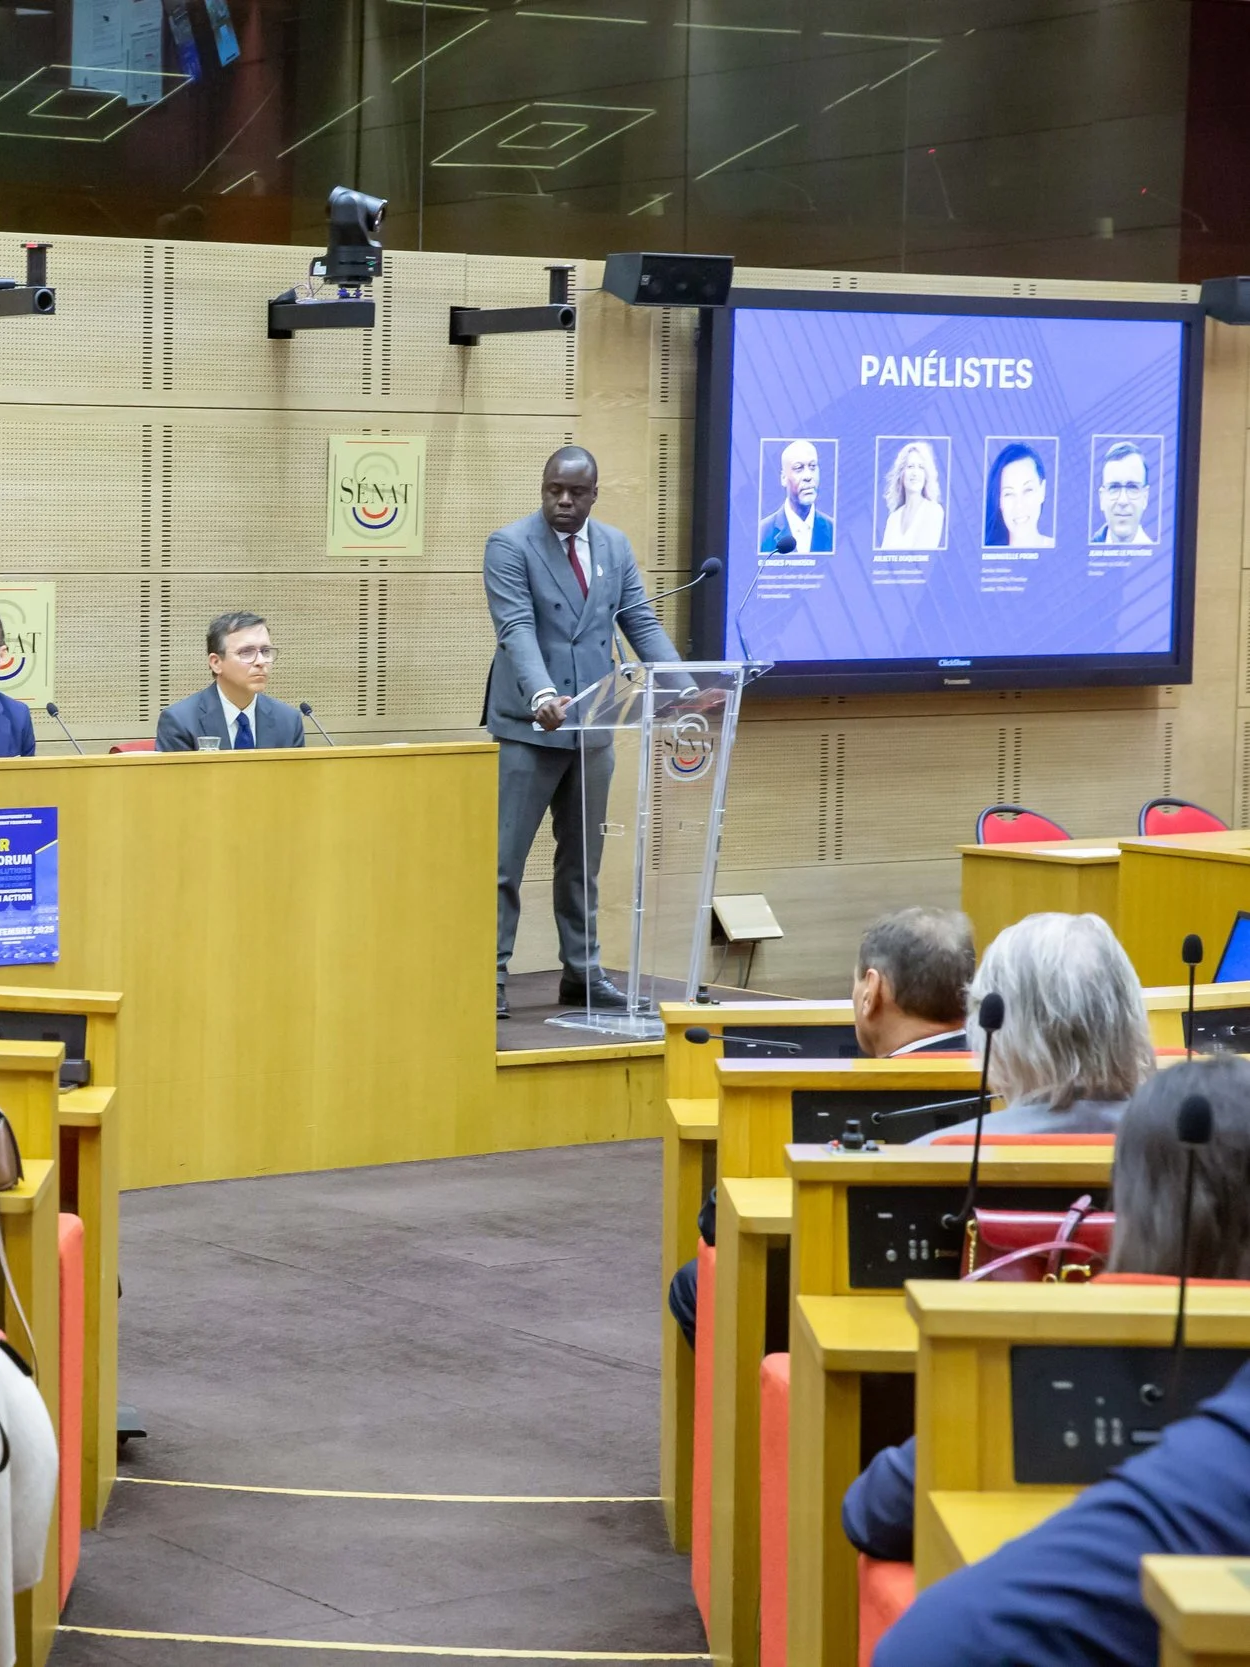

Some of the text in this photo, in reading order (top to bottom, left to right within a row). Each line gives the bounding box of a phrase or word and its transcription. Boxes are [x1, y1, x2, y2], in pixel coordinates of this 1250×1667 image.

[861, 350, 1033, 389] PANÉLISTES
[340, 476, 413, 504] SÉNAT
[3, 893, 33, 902] ACTION
